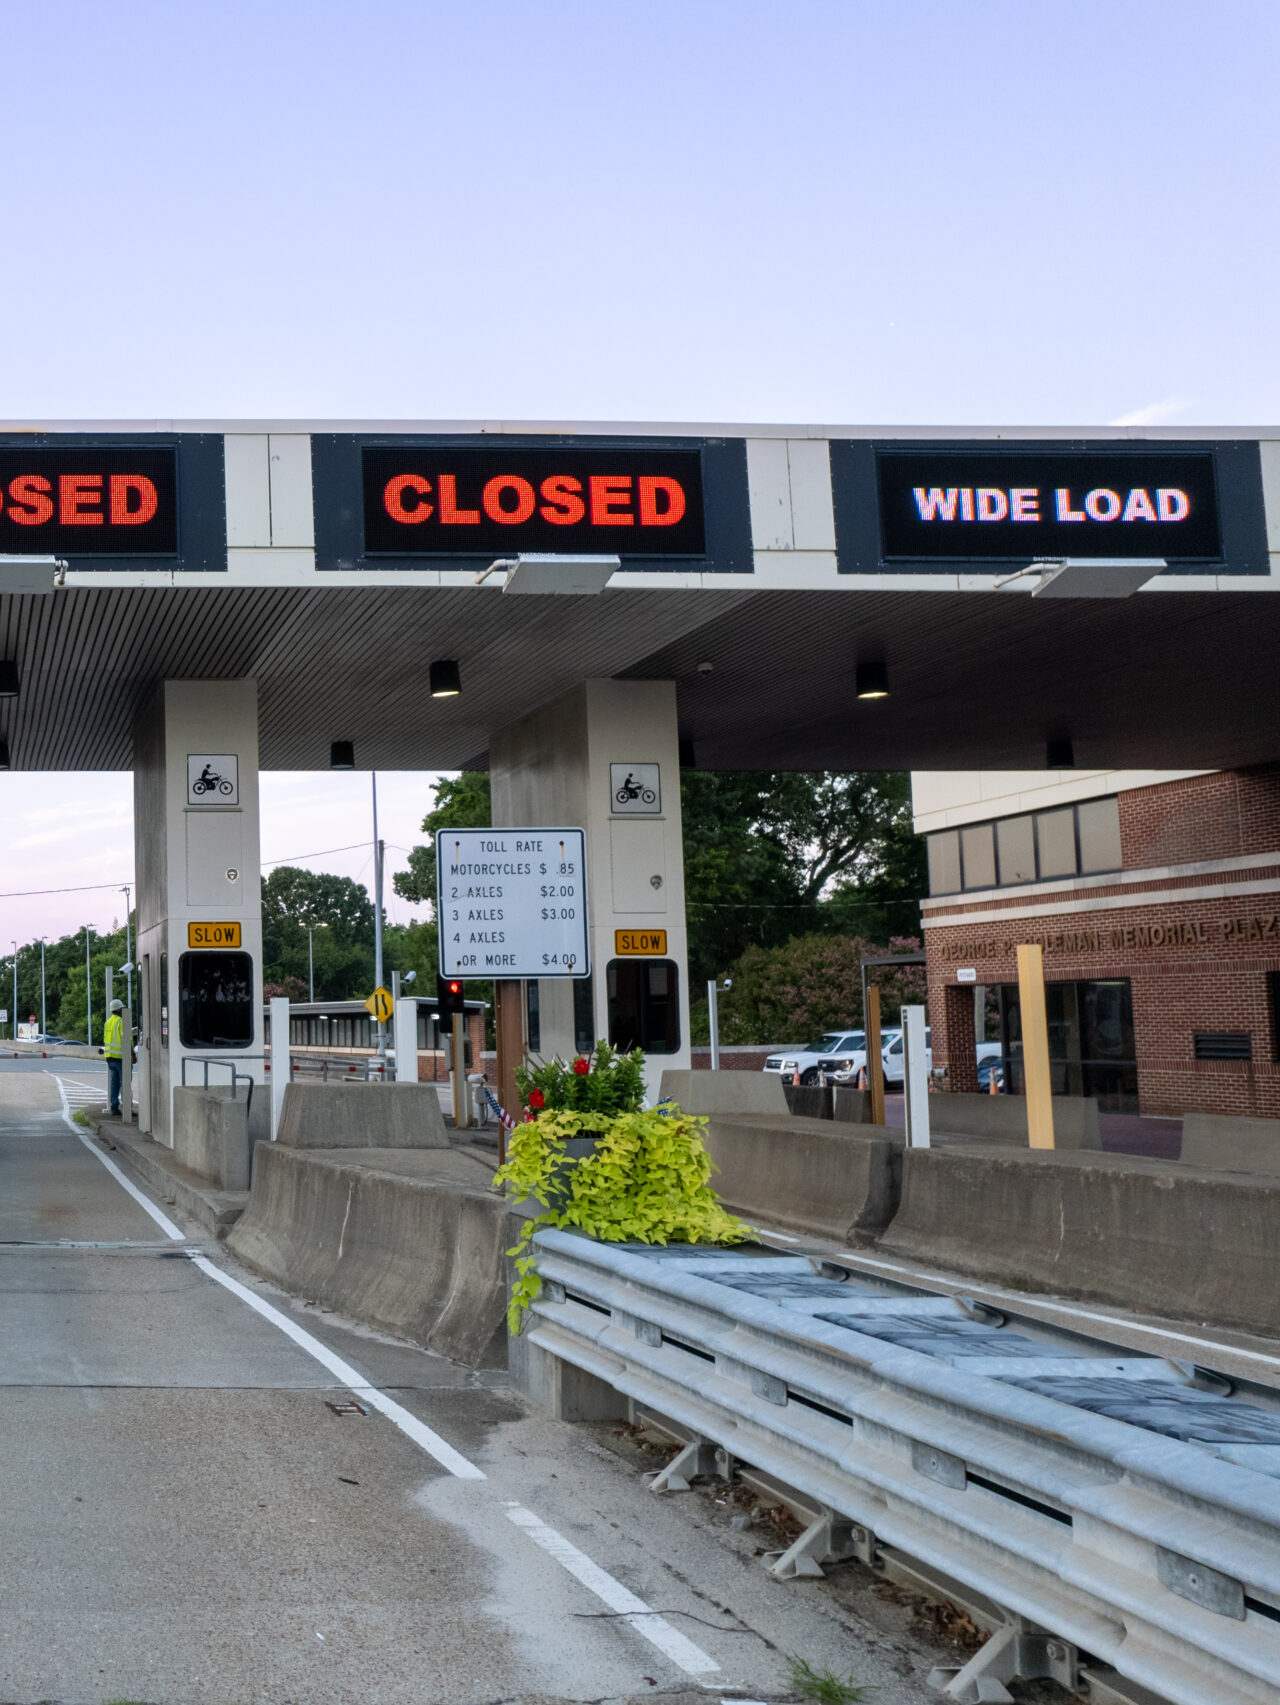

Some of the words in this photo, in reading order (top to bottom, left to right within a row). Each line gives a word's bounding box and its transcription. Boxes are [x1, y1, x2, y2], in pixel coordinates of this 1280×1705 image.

[384, 475, 685, 526] CLOSED
[913, 488, 1041, 521] WIDE
[1054, 489, 1190, 522] LOAD
[480, 841, 507, 852] TOLL
[516, 841, 542, 852] RATE
[451, 863, 530, 875] MOTORCYCLES
[540, 863, 547, 875] $
[452, 887, 458, 898] 2
[467, 886, 503, 898] AXLES
[540, 885, 574, 898] $2.00
[453, 910, 459, 921] 3
[468, 909, 503, 920] AXLES
[541, 908, 575, 920] $3.00
[195, 928, 234, 942] SLOW
[453, 933, 460, 943] 4
[470, 932, 505, 943] AXLES
[1110, 922, 1207, 948] MEMORIAL
[622, 935, 660, 949] SLOW
[462, 955, 477, 966] OR
[486, 954, 515, 966] MORE
[542, 954, 576, 966] $4.00
